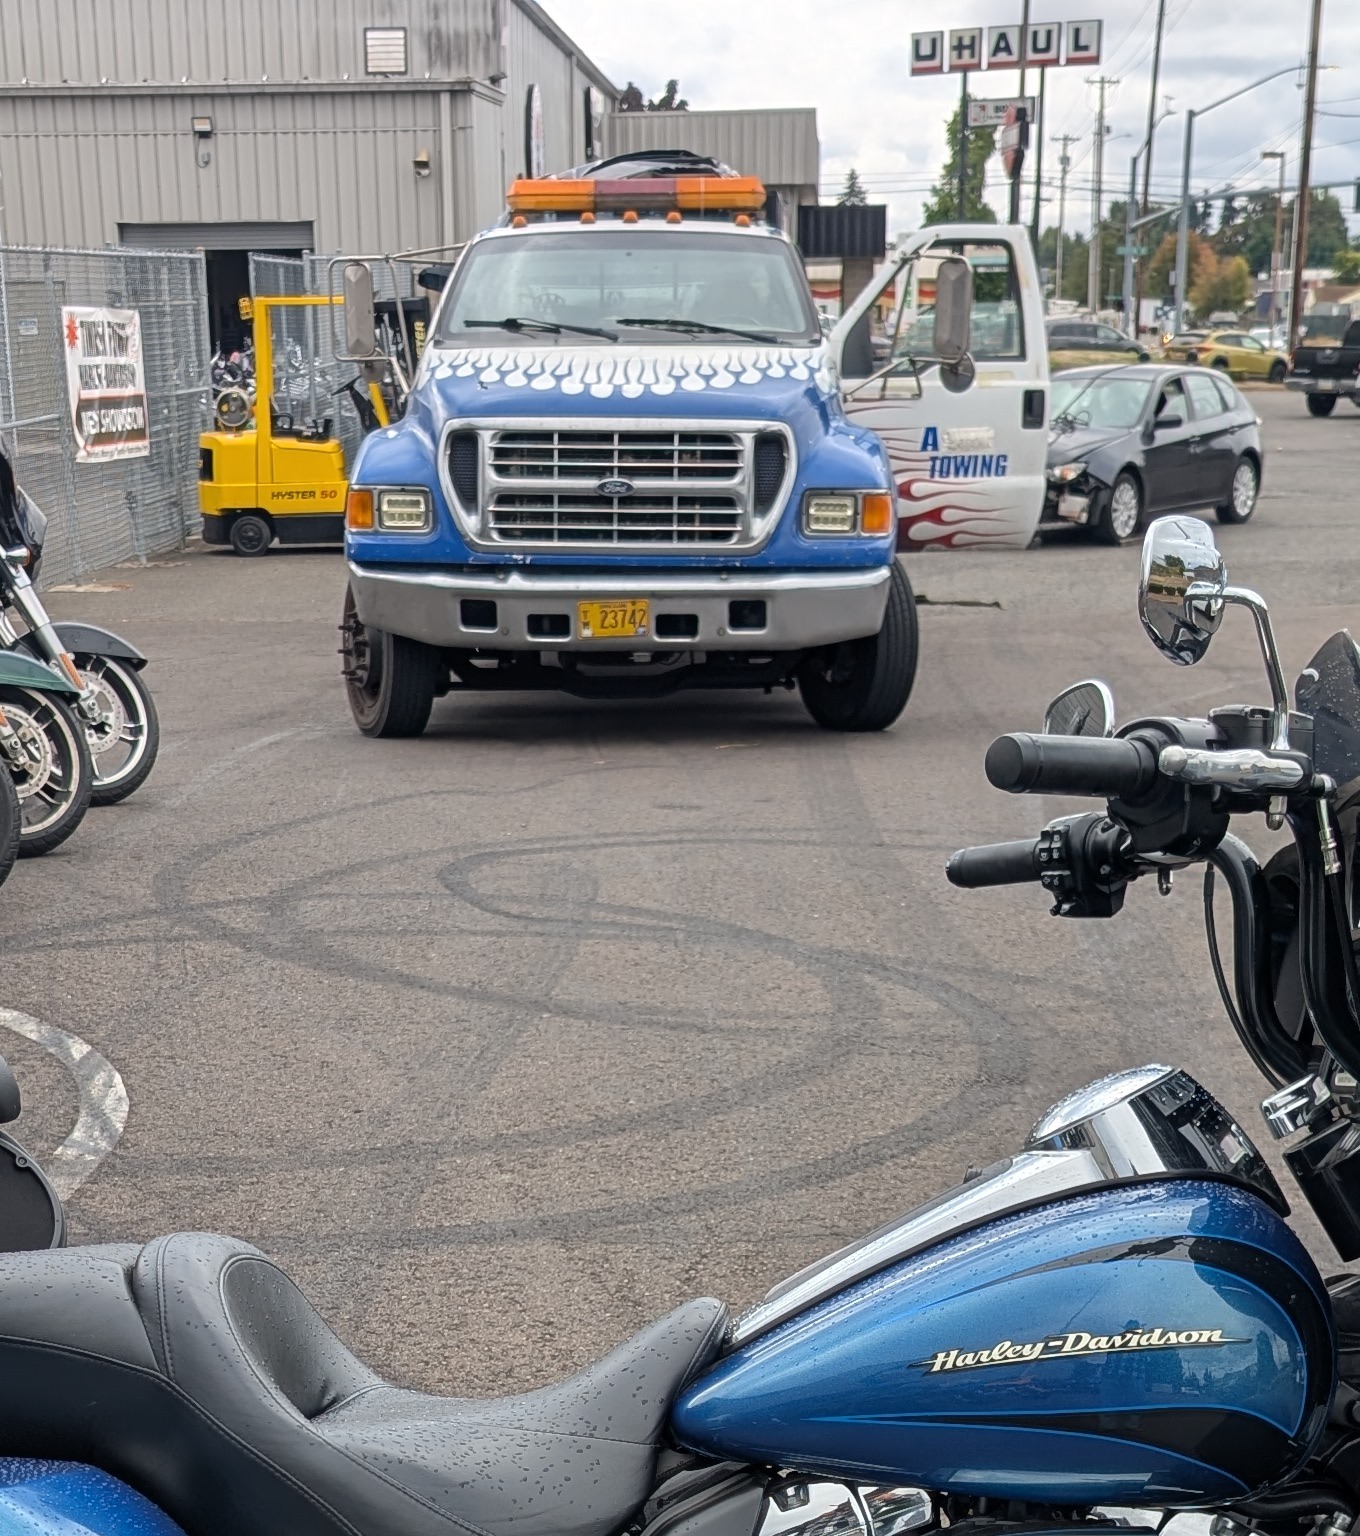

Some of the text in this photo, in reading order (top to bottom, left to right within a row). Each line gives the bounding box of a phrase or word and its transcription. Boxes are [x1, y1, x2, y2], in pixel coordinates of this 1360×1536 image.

[921, 426, 939, 452] A
[928, 454, 1008, 479] TOWING
[271, 490, 338, 500] HYSTER 50
[603, 482, 628, 493] Ford
[599, 609, 647, 630] 23742
[928, 1328, 1224, 1373] Harley-Davidson
